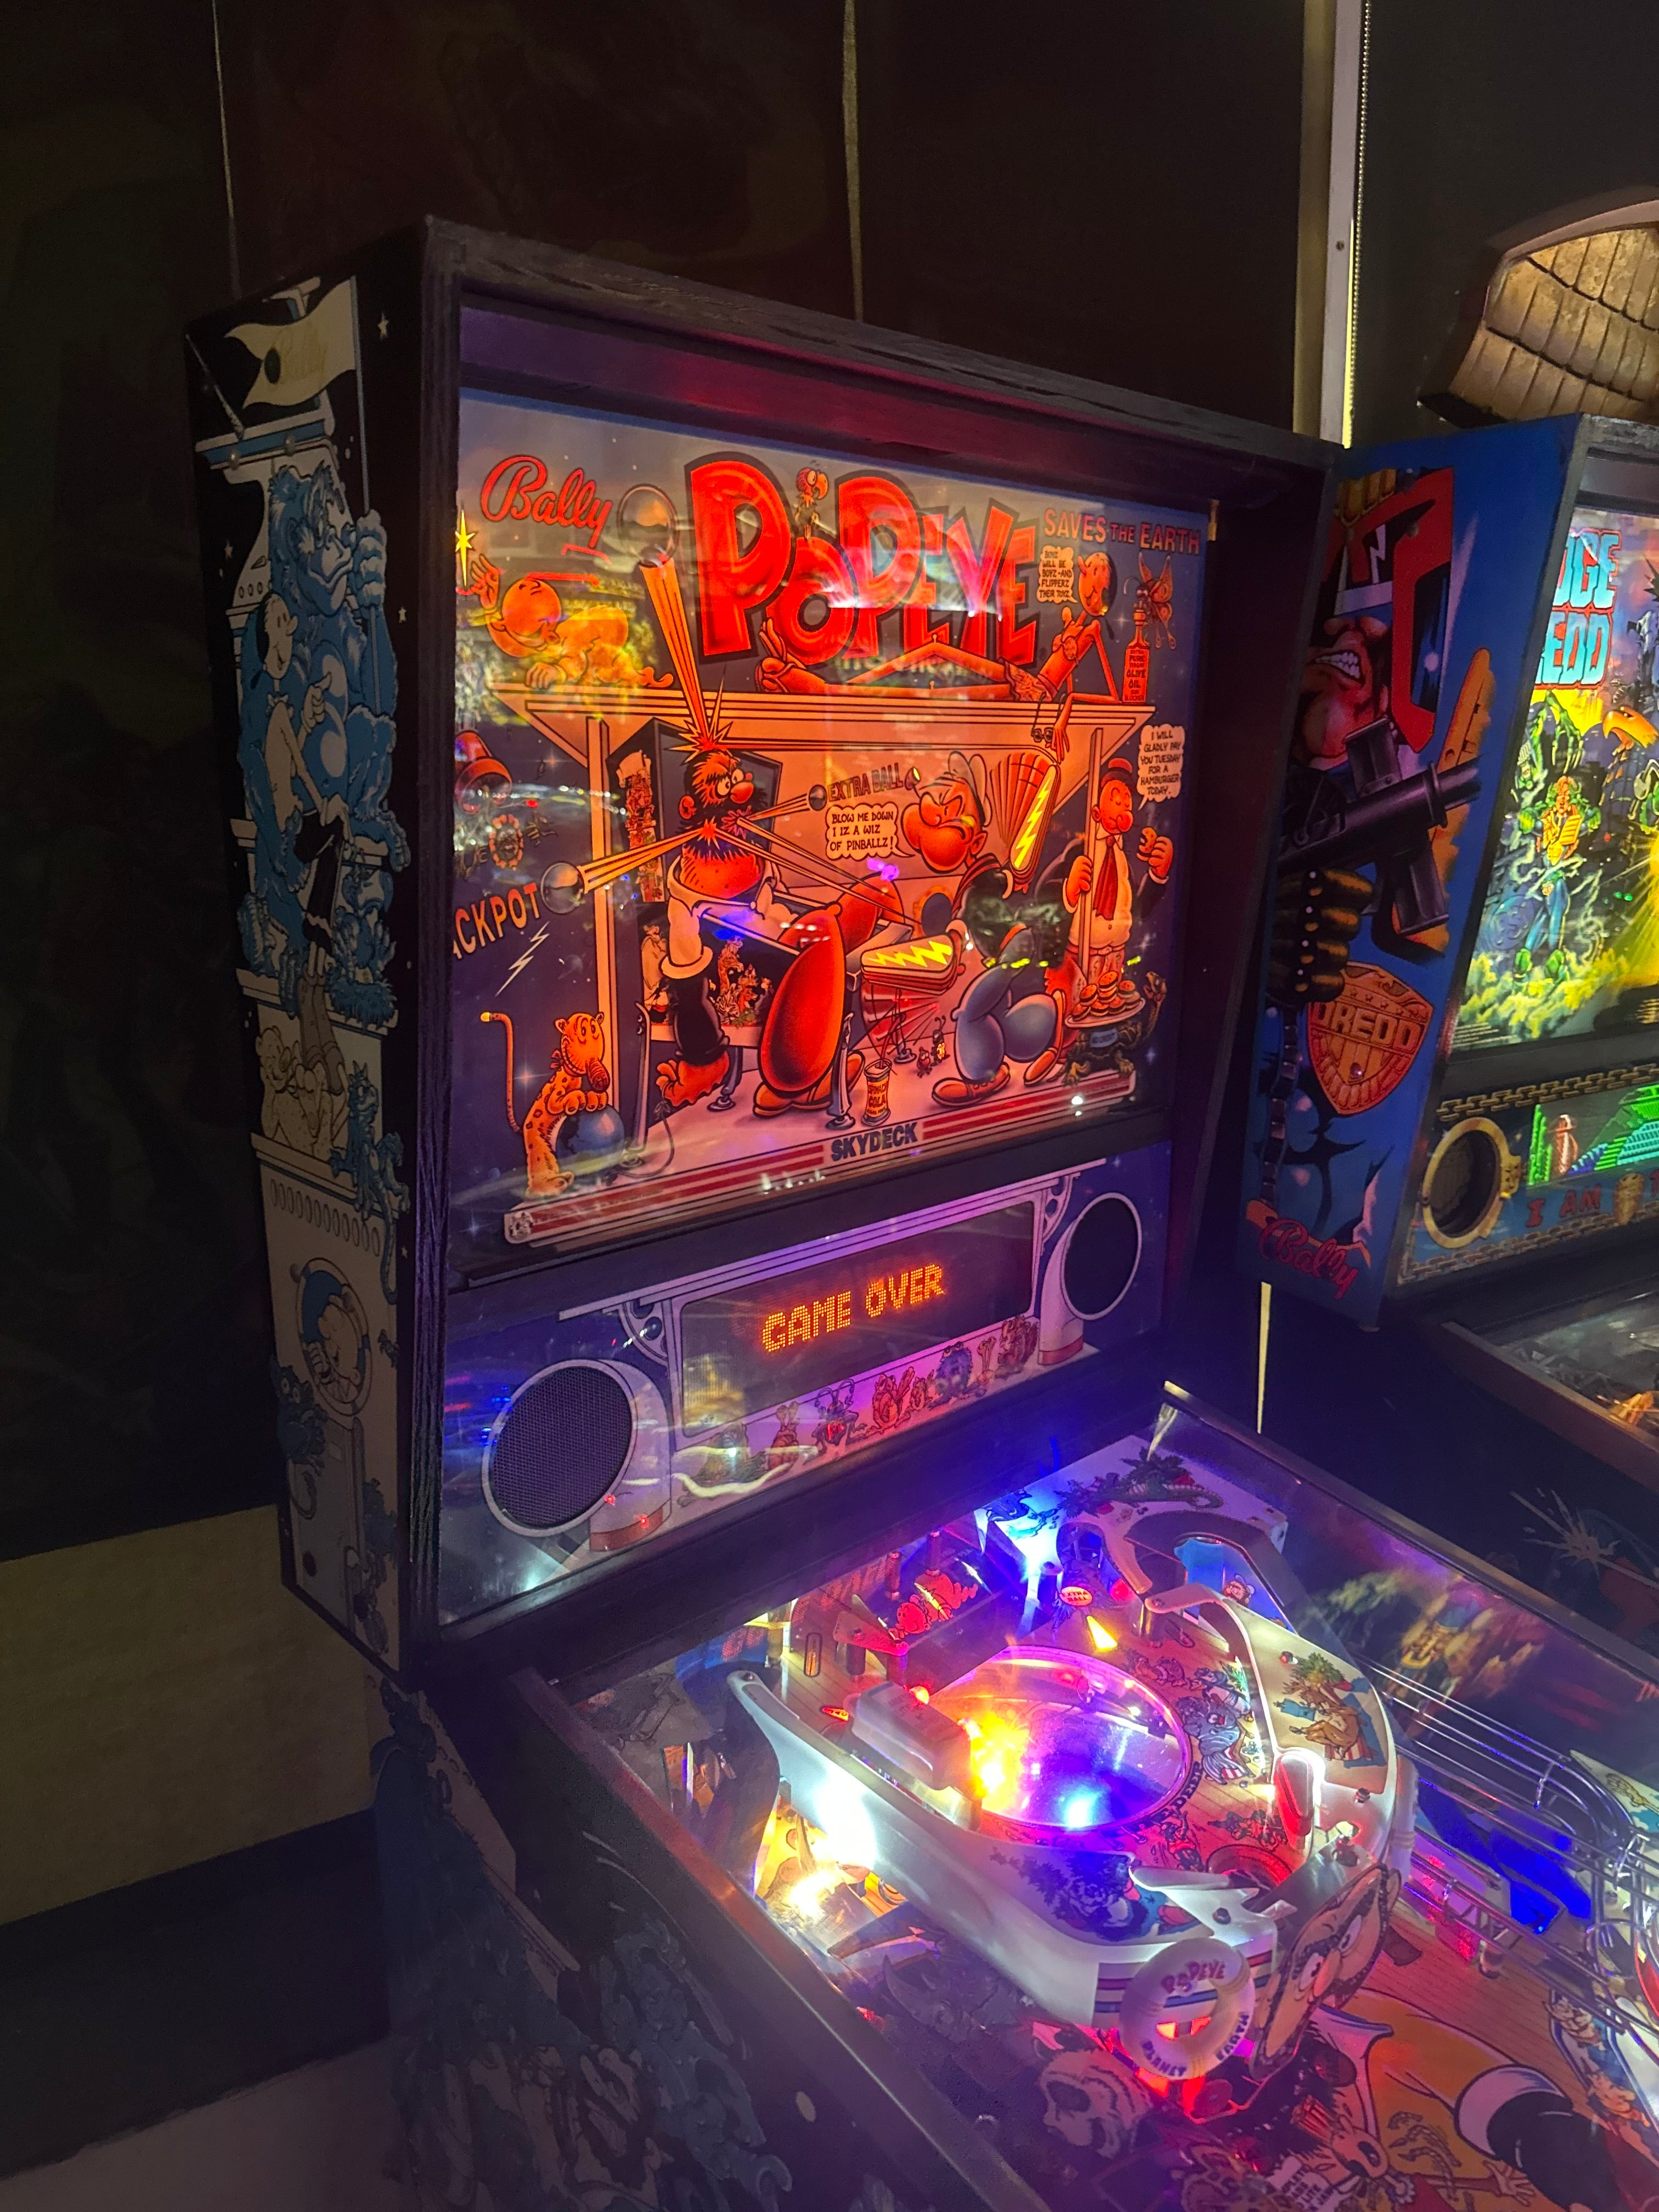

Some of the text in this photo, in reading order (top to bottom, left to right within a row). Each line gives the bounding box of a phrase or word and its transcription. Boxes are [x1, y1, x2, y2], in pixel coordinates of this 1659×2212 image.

[481, 455, 612, 548] Bally
[1044, 509, 1201, 555] SAVES THE EARTH
[686, 453, 1039, 665] POPEYE
[1041, 579, 1069, 588] FLIPPERZ
[1128, 679, 1141, 689] OIL
[1144, 742, 1181, 752] GLADLY PAY
[1151, 731, 1173, 740] I WILL
[1141, 754, 1181, 765] YOU TUESDAY
[1148, 766, 1160, 774] FOR
[827, 763, 904, 802] EXTRA BALL
[1141, 774, 1180, 786] HAMBURGER
[832, 811, 894, 824] BLOW ME DOWN
[833, 825, 881, 837] I IZ A WIZ
[830, 841, 842, 851] OF
[1310, 1001, 1425, 1052] DREDD
[831, 1122, 918, 1161] SKYDECK
[1525, 1184, 1601, 1227] I AM
[1259, 1218, 1359, 1300] Bally
[761, 1264, 944, 1352] GAME OVER
[1160, 1959, 1226, 1994] POPEYE
